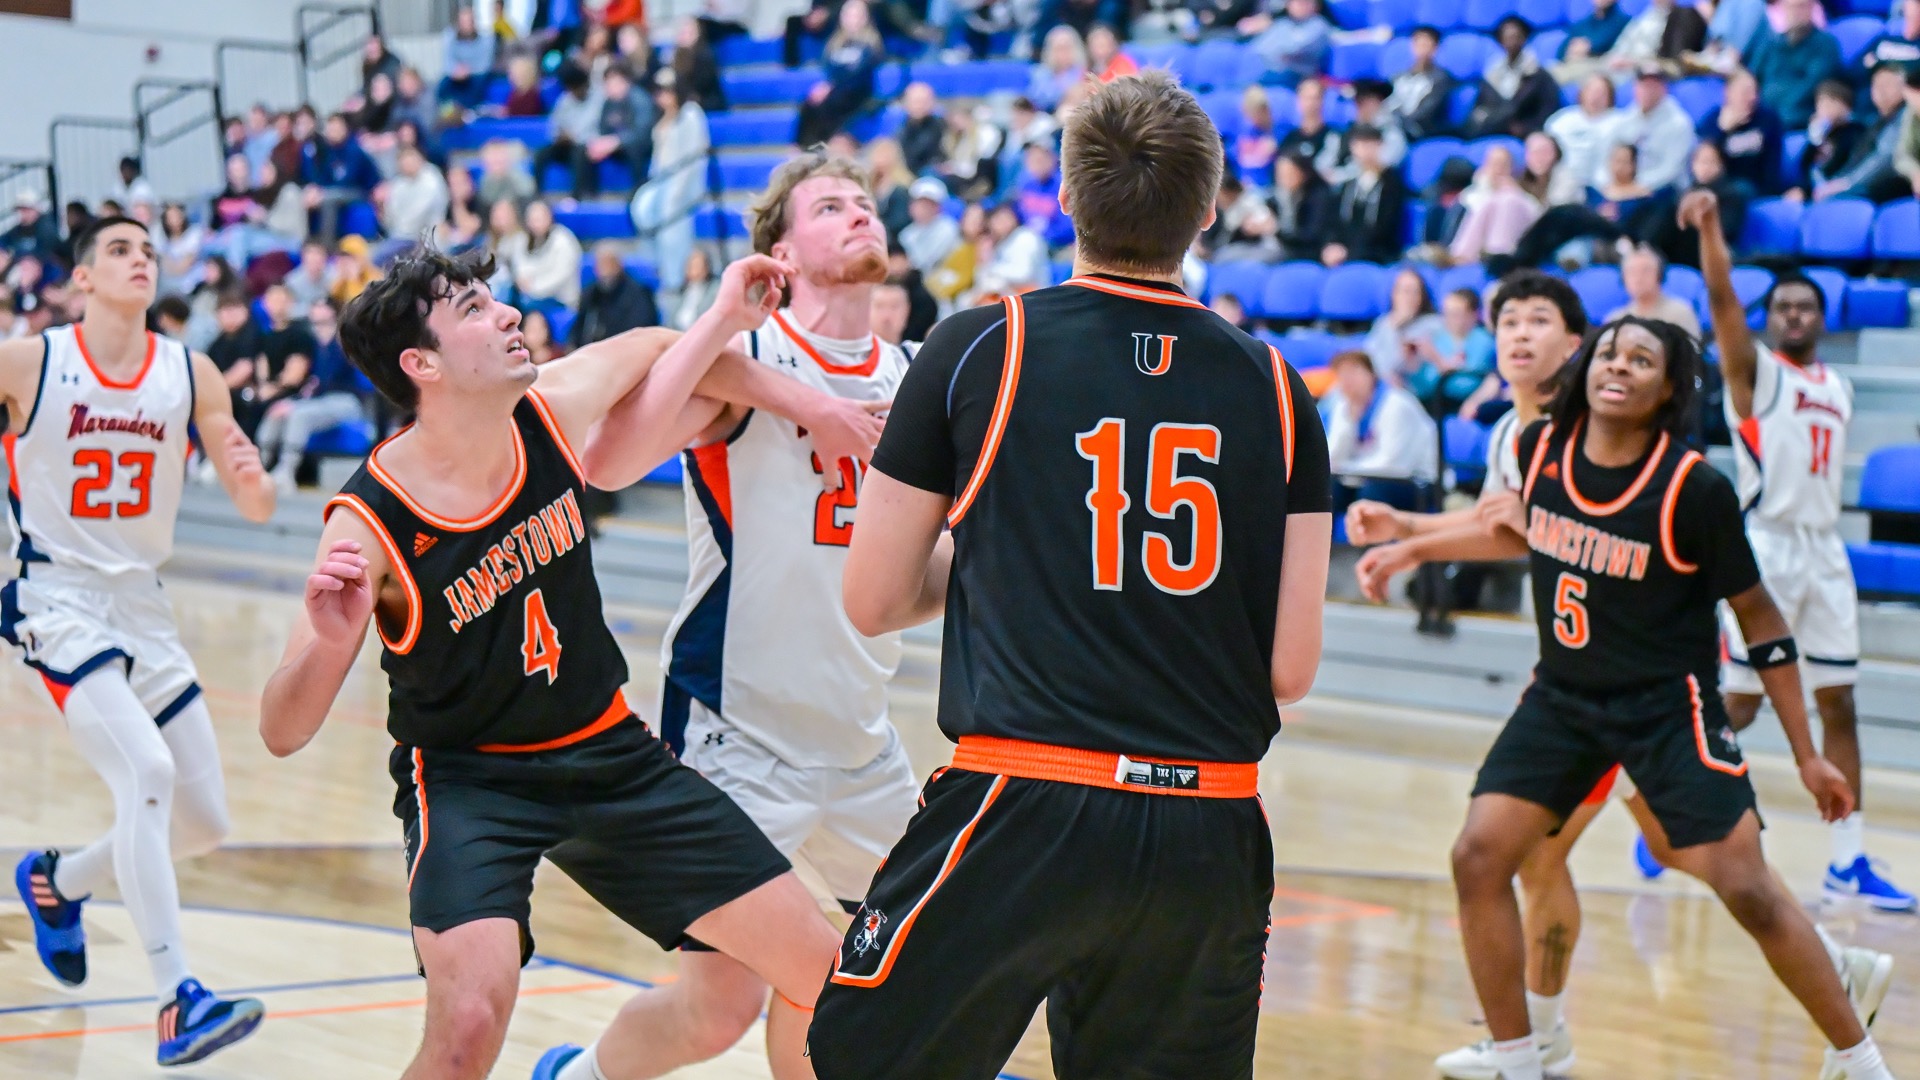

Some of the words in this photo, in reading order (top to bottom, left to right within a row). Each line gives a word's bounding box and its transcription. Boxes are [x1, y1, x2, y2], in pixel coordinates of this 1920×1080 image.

[1131, 332, 1179, 376] U
[67, 403, 166, 442] Marauders
[70, 448, 156, 519] 23
[810, 450, 868, 547] 2
[1075, 417, 1223, 596] 15
[443, 488, 585, 634] JAMESTOWN
[1527, 504, 1651, 581] JAMESTOWN
[520, 588, 562, 686] 4
[1553, 571, 1591, 649] 5
[1156, 767, 1170, 778] 2XL
